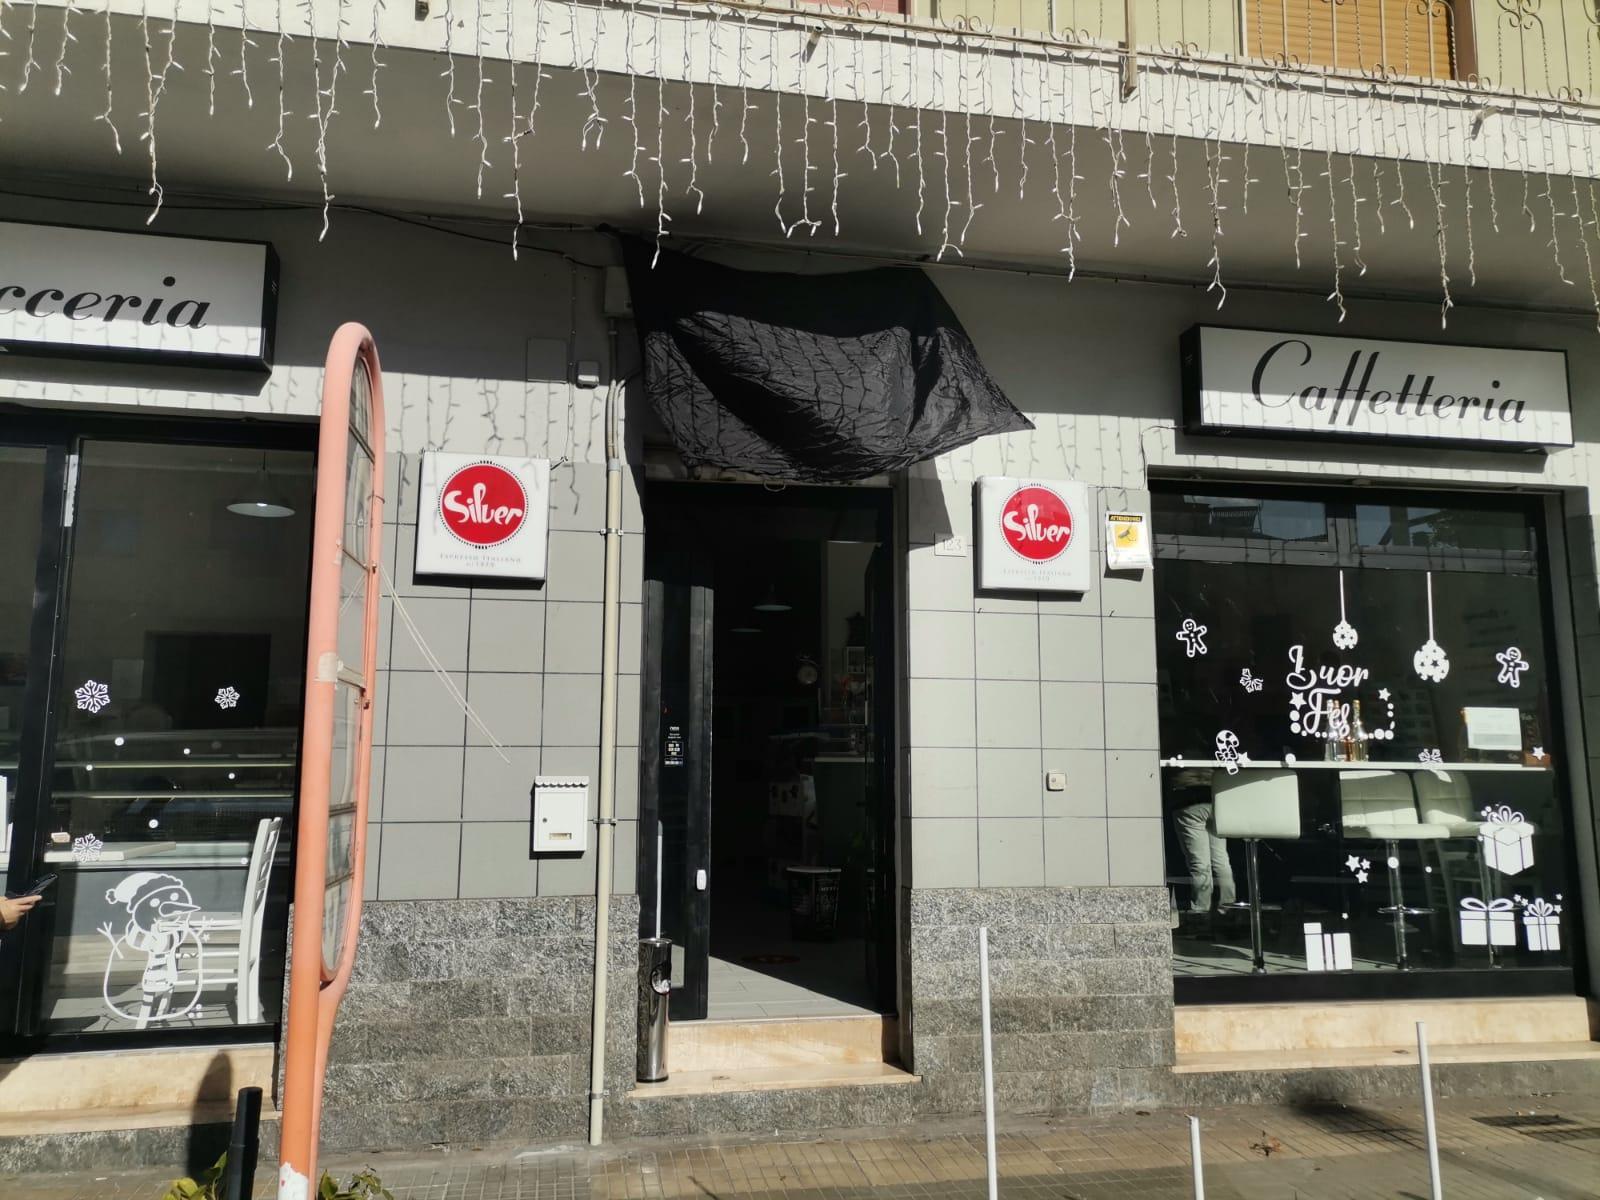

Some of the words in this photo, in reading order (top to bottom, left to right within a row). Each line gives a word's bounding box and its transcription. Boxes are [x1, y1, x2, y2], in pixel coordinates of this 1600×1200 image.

[1251, 339, 1526, 427] Caffetteria
[443, 482, 523, 525] Silver
[1003, 503, 1071, 543] Silver
